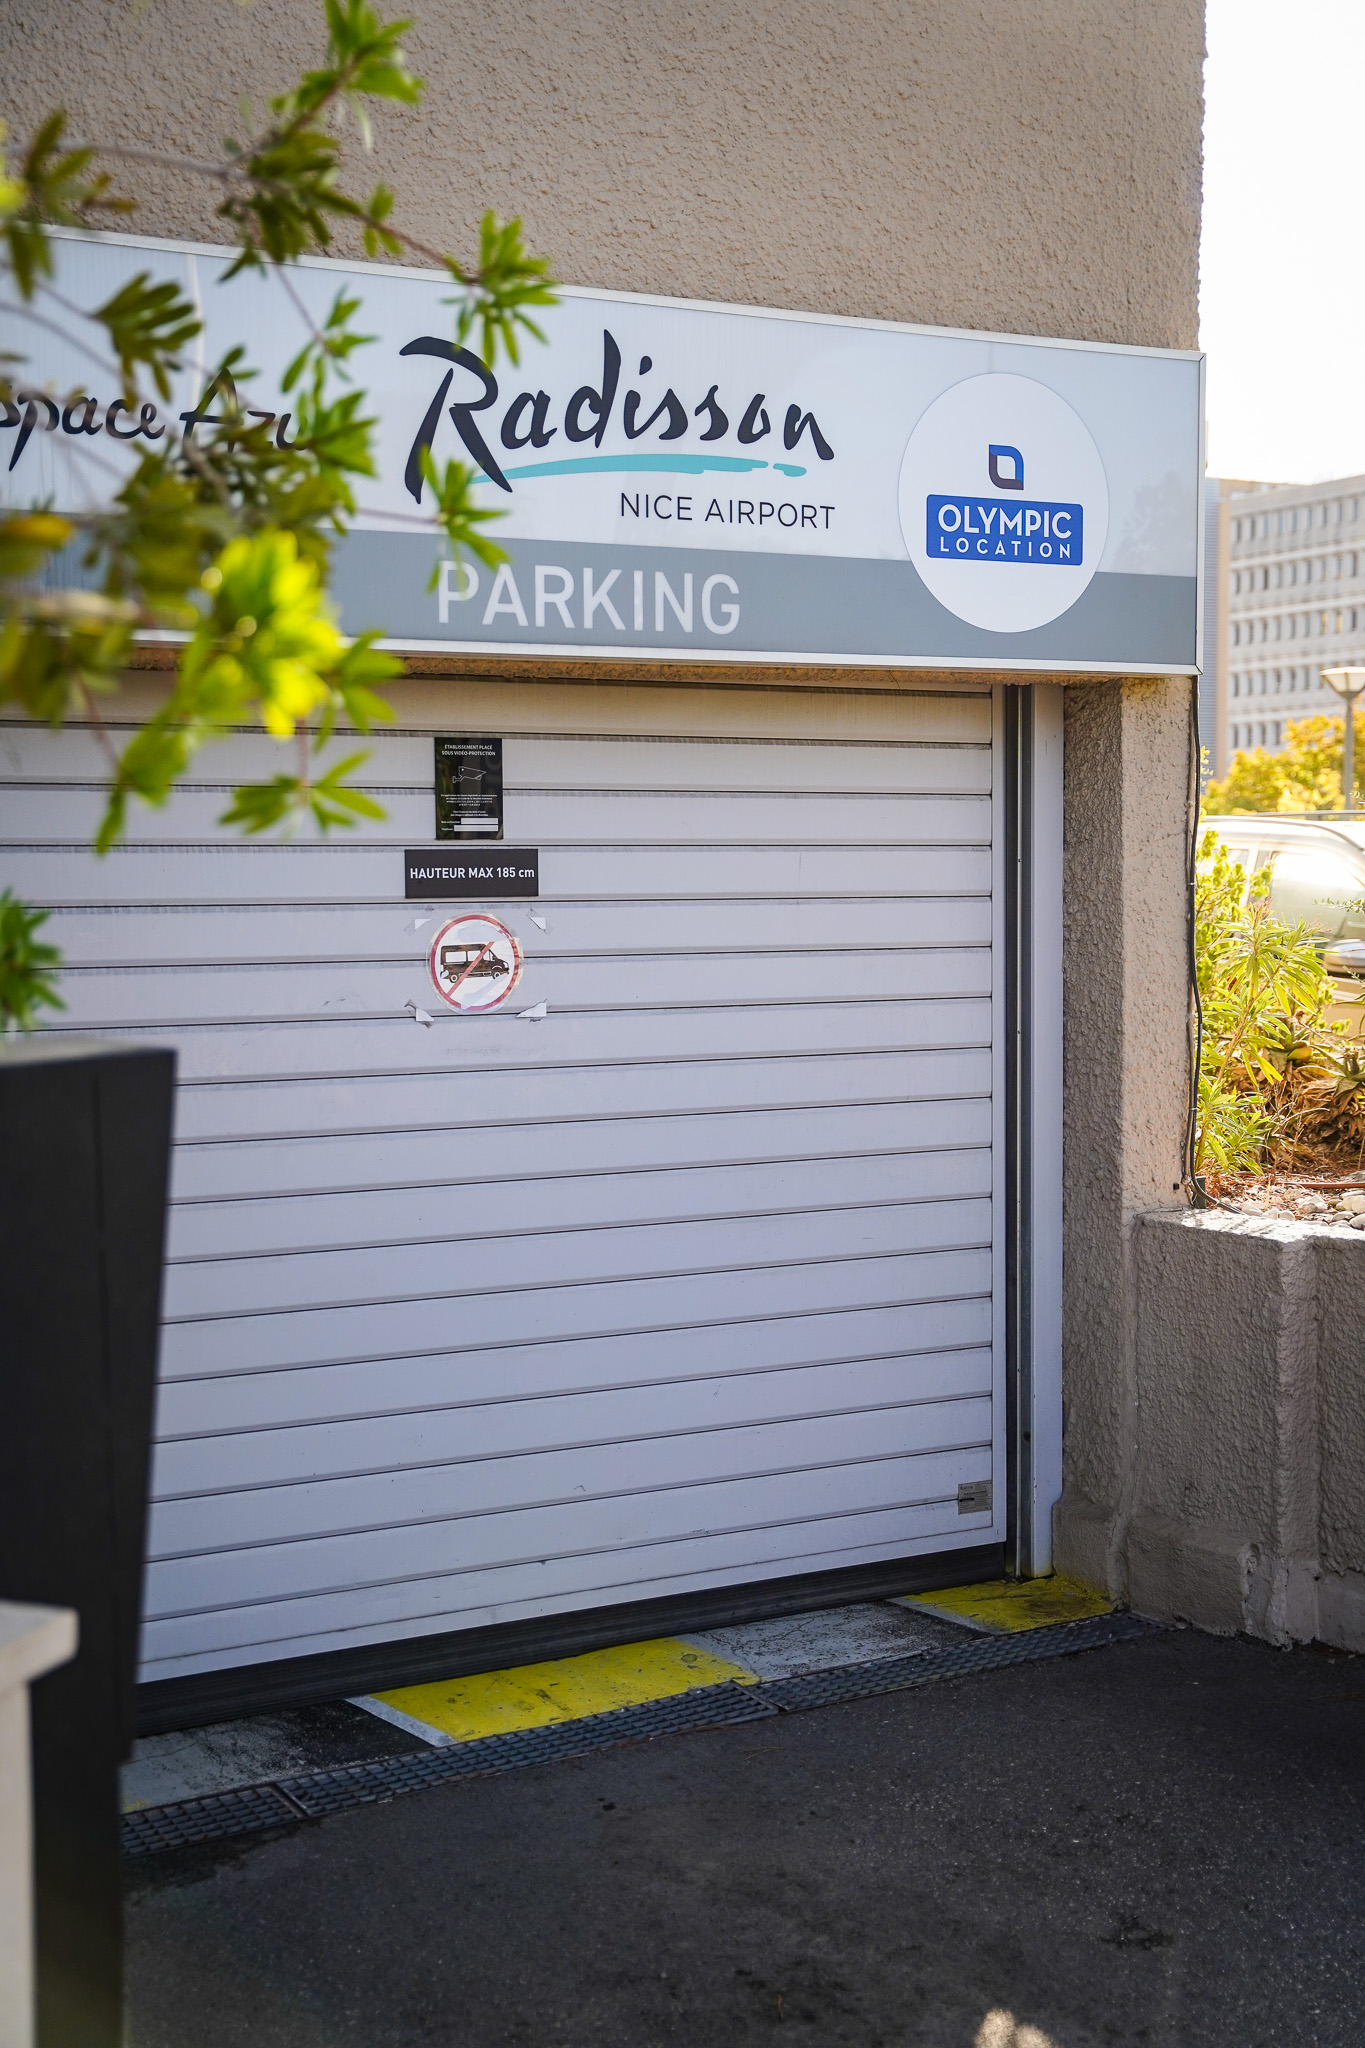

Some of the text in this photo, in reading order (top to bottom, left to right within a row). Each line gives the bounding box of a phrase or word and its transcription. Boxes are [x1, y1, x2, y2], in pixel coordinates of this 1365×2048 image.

[399, 329, 835, 504] Radisson
[620, 492, 836, 529] NICE AIRPORT
[937, 504, 1072, 539] OLYMPIC
[940, 536, 1071, 559] LOCATION
[437, 560, 741, 635] PARKING
[410, 866, 535, 879] HAUTEUR MAX 185 cm
